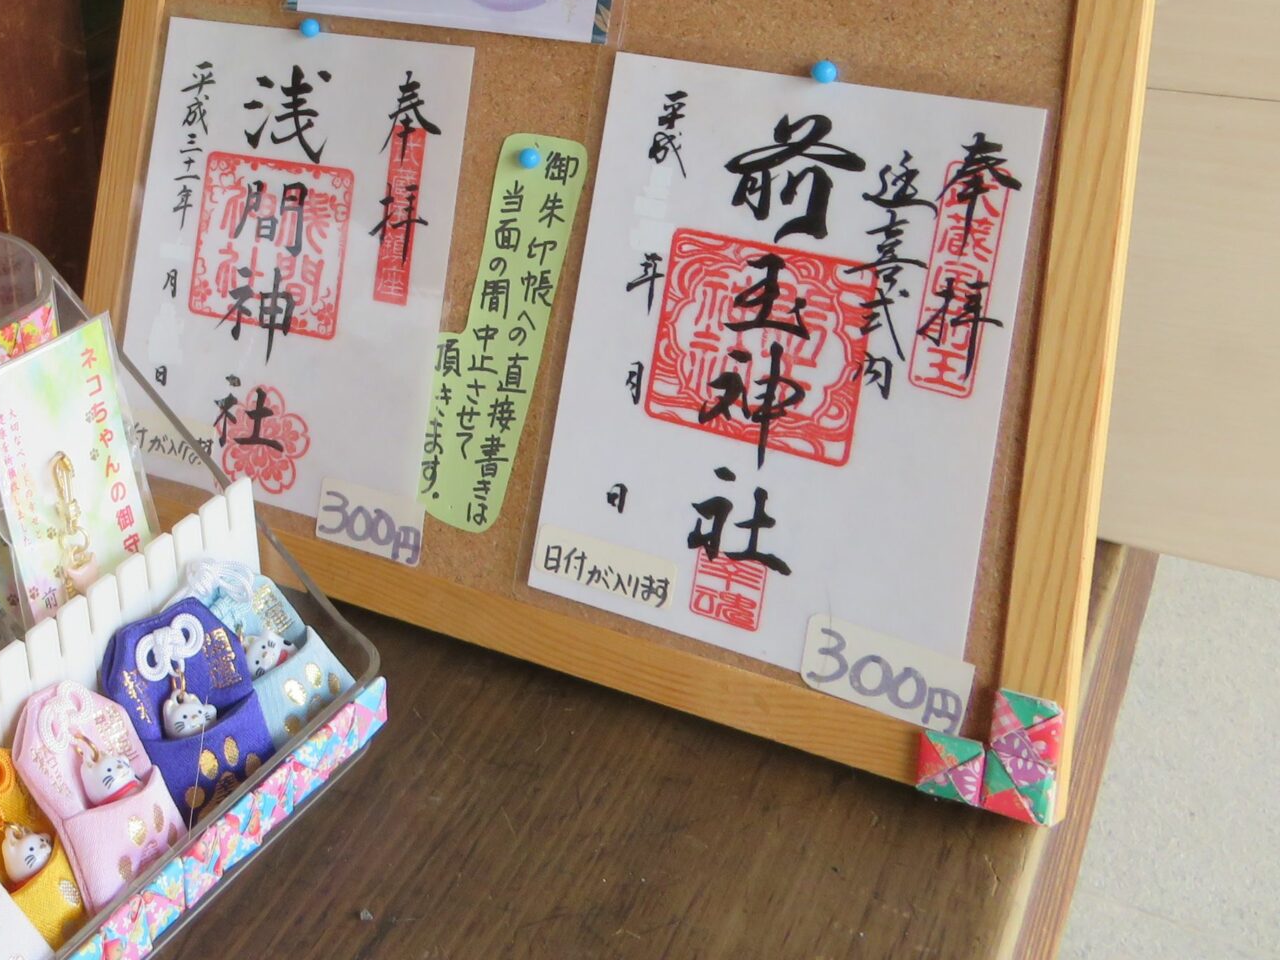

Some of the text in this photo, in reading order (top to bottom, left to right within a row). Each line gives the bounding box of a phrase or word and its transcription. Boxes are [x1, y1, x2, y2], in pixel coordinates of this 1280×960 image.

[648, 90, 690, 179] 平成
[154, 60, 217, 386] 平成三十一年 月 日
[213, 64, 333, 453] 浅間神社
[456, 180, 524, 461] 当面の間中止させて
[466, 150, 580, 525] 御朱印帳への直接書きは
[624, 359, 643, 407] 月
[687, 113, 868, 576] 前玉神社
[421, 337, 461, 501] 頂きます。
[318, 490, 422, 565] 300円
[606, 482, 629, 515] 日
[543, 542, 672, 608] 日付が入ります
[804, 628, 964, 736] 300円
